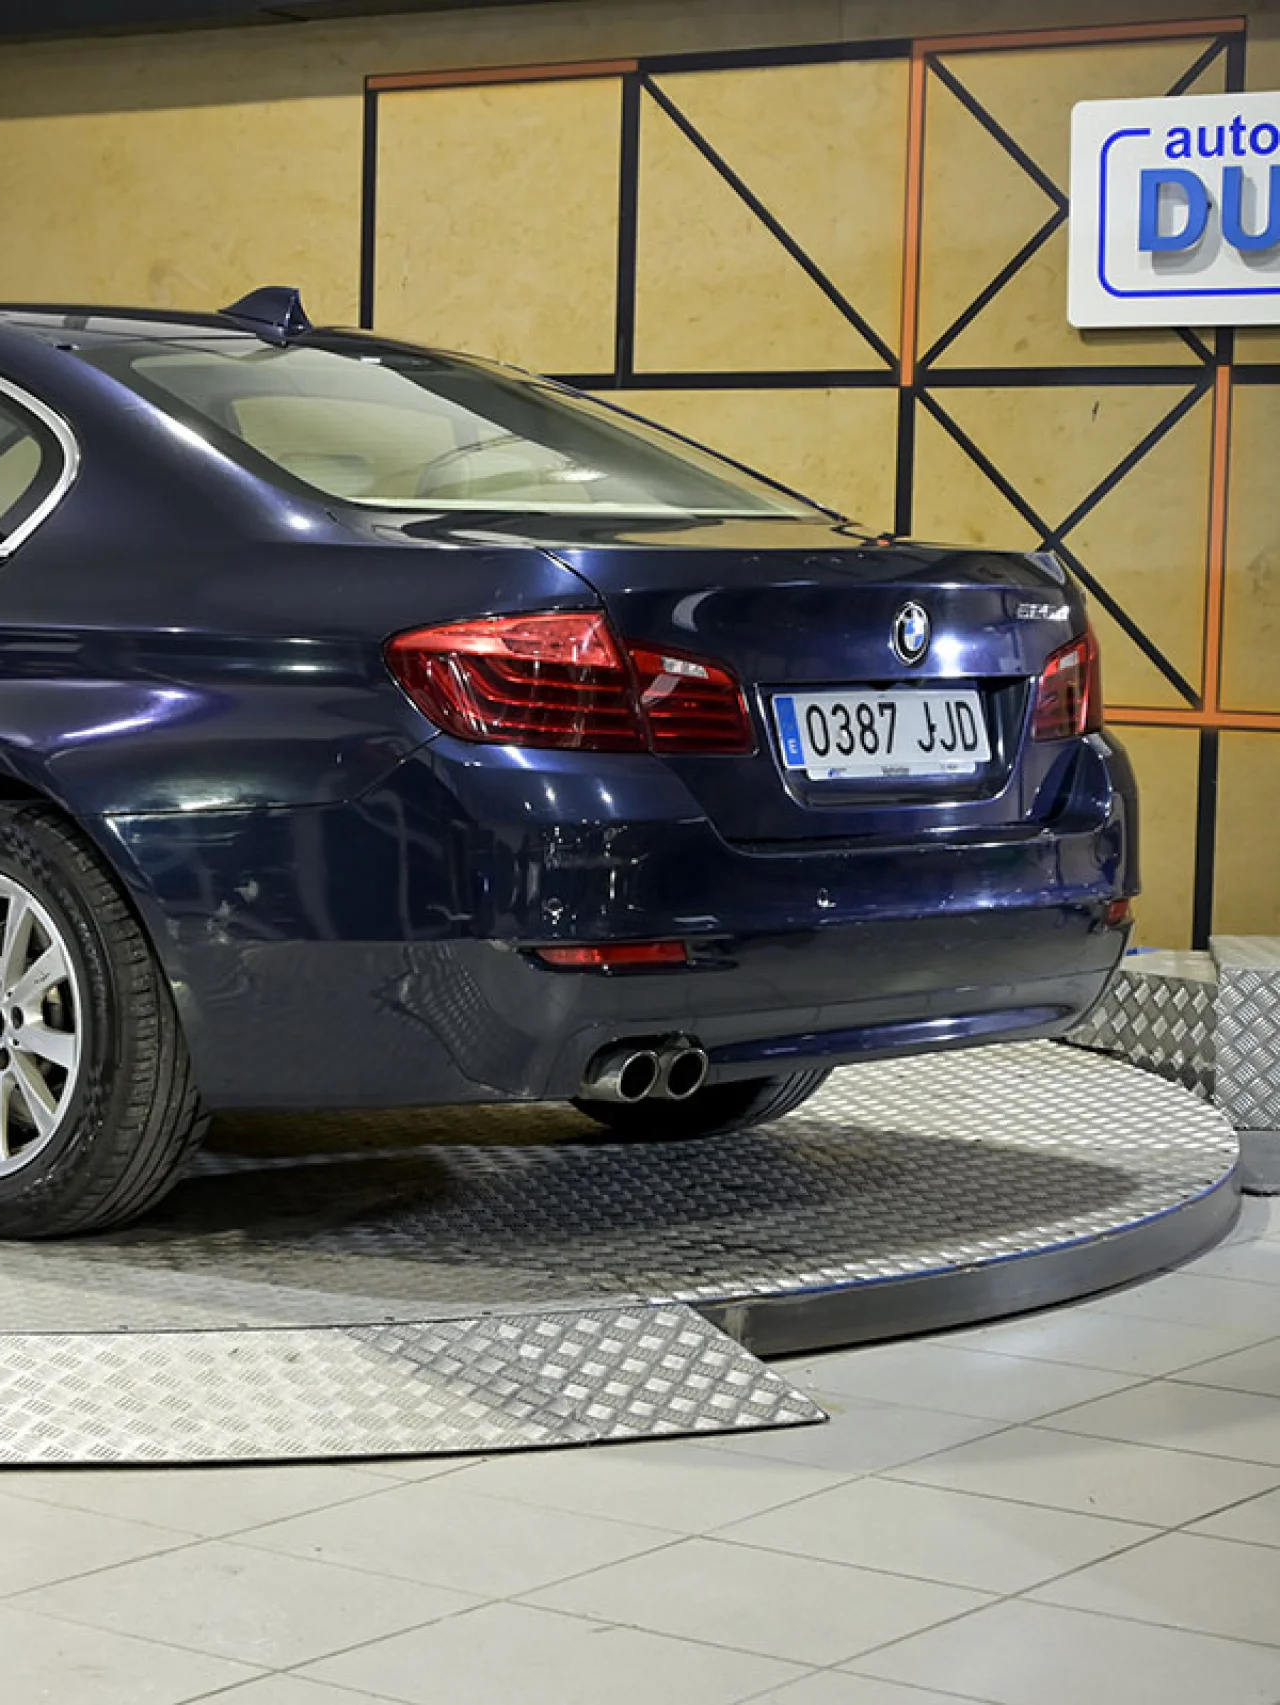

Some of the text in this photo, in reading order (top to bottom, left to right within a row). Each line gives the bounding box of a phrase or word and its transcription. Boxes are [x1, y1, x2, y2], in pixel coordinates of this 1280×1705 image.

[1164, 114, 1280, 159] auto
[1138, 164, 1280, 253] DU
[806, 700, 979, 757] 0387 JJD
